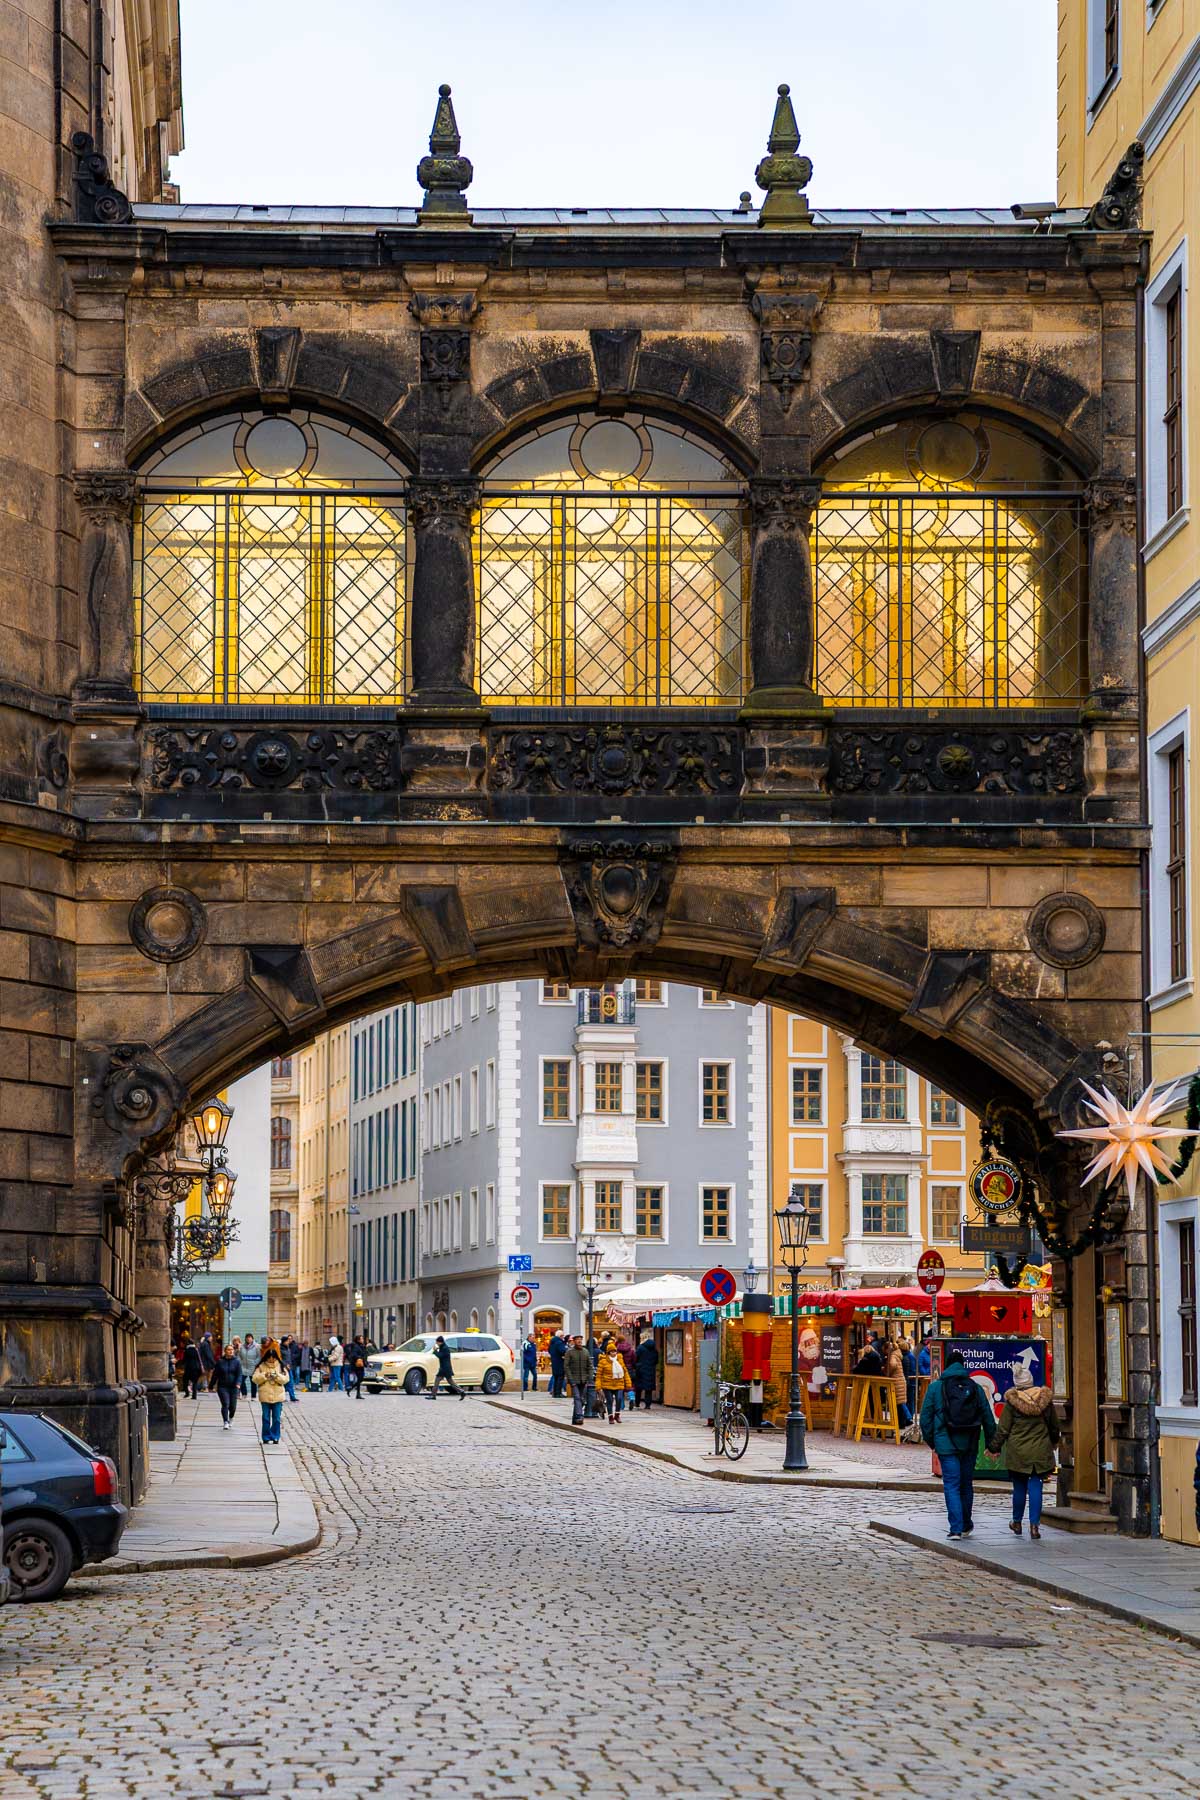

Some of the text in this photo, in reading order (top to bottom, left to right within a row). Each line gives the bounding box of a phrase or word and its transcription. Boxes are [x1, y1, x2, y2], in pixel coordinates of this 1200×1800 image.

[977, 1164, 1019, 1183] PAULANER
[979, 1196, 1015, 1210] MÜNCHEN
[971, 1230, 1024, 1245] Eingang
[963, 1360, 1015, 1369] riezelmark
